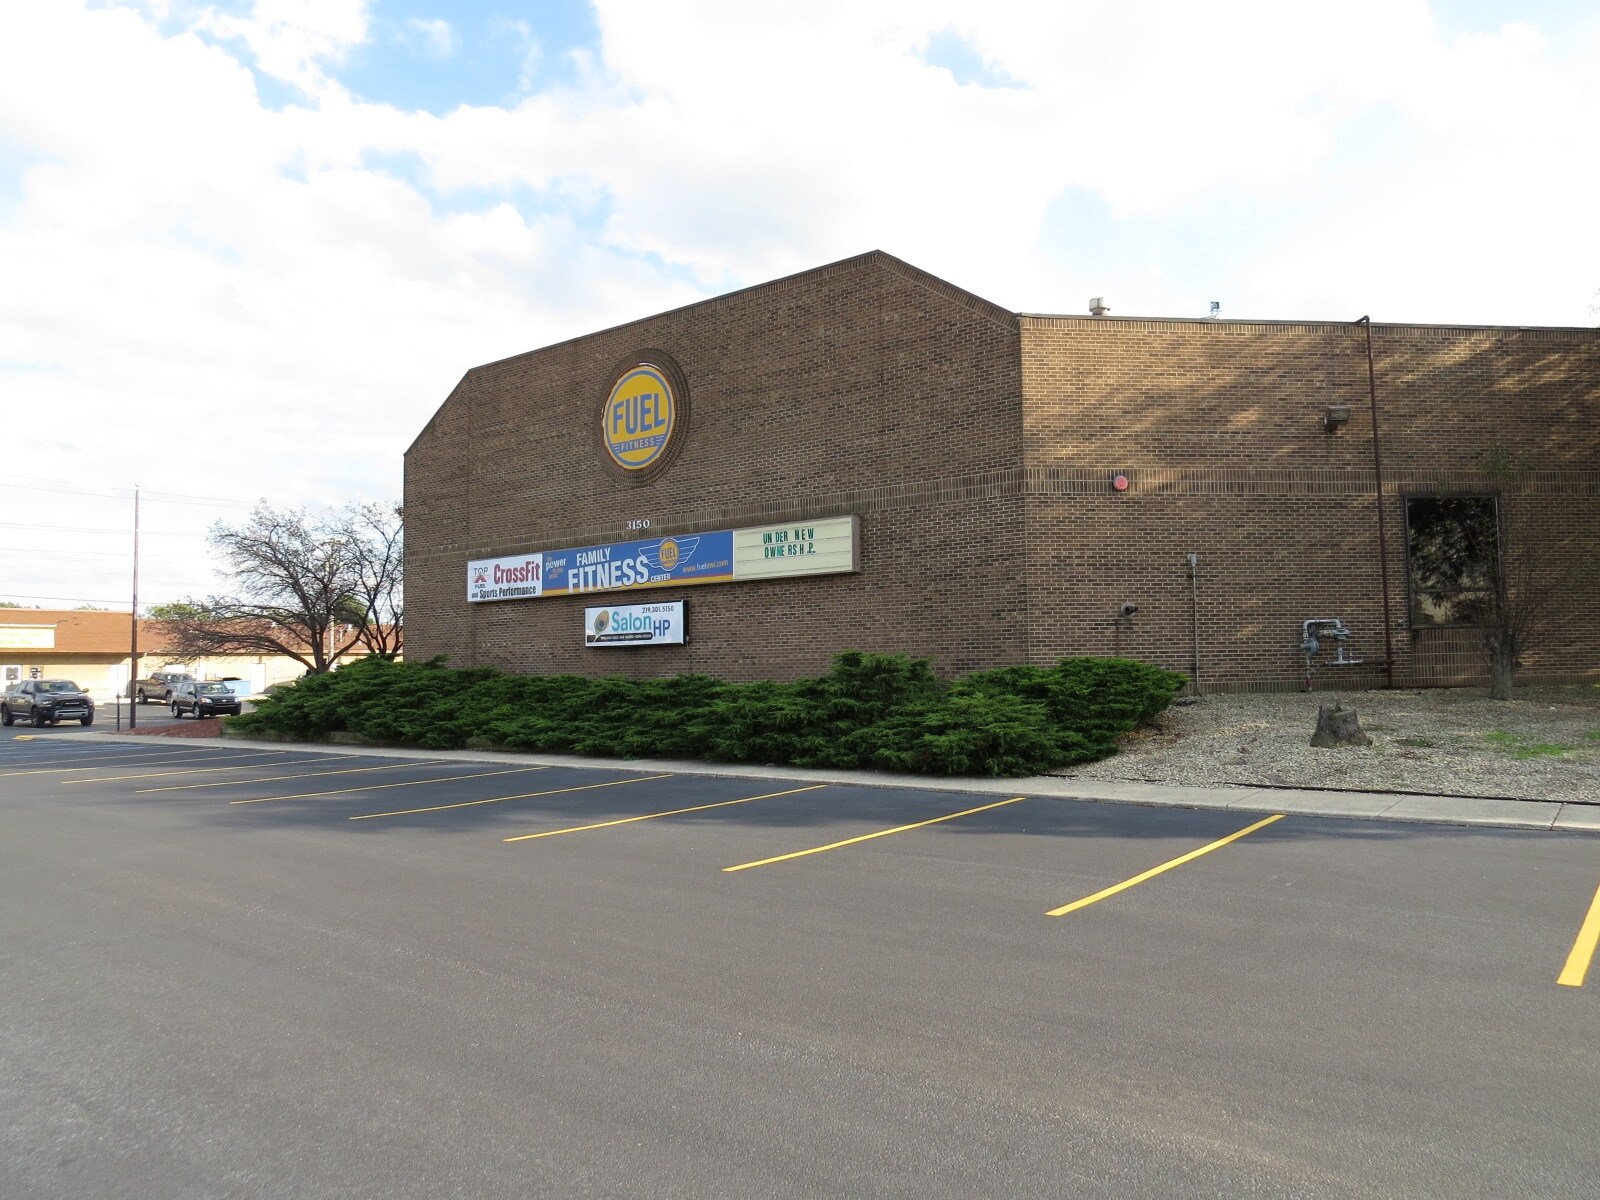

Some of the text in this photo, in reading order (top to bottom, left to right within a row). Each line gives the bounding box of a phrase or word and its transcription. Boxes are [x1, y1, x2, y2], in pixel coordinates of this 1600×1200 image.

[613, 393, 666, 435] FUEL
[620, 436, 656, 452] FITNESS
[626, 519, 650, 530] 3150
[763, 528, 814, 544] UNDER NEW
[576, 547, 612, 567] FAMILY
[661, 547, 677, 560] FUEL
[473, 566, 489, 576] TOP
[493, 560, 541, 585] CrossFit
[545, 558, 567, 572] power
[568, 555, 649, 594] FITNESS
[650, 573, 671, 583] CENTER
[479, 588, 498, 600] Sports
[498, 585, 537, 597] Performance
[611, 611, 652, 632] Salon
[652, 619, 671, 637] HP
